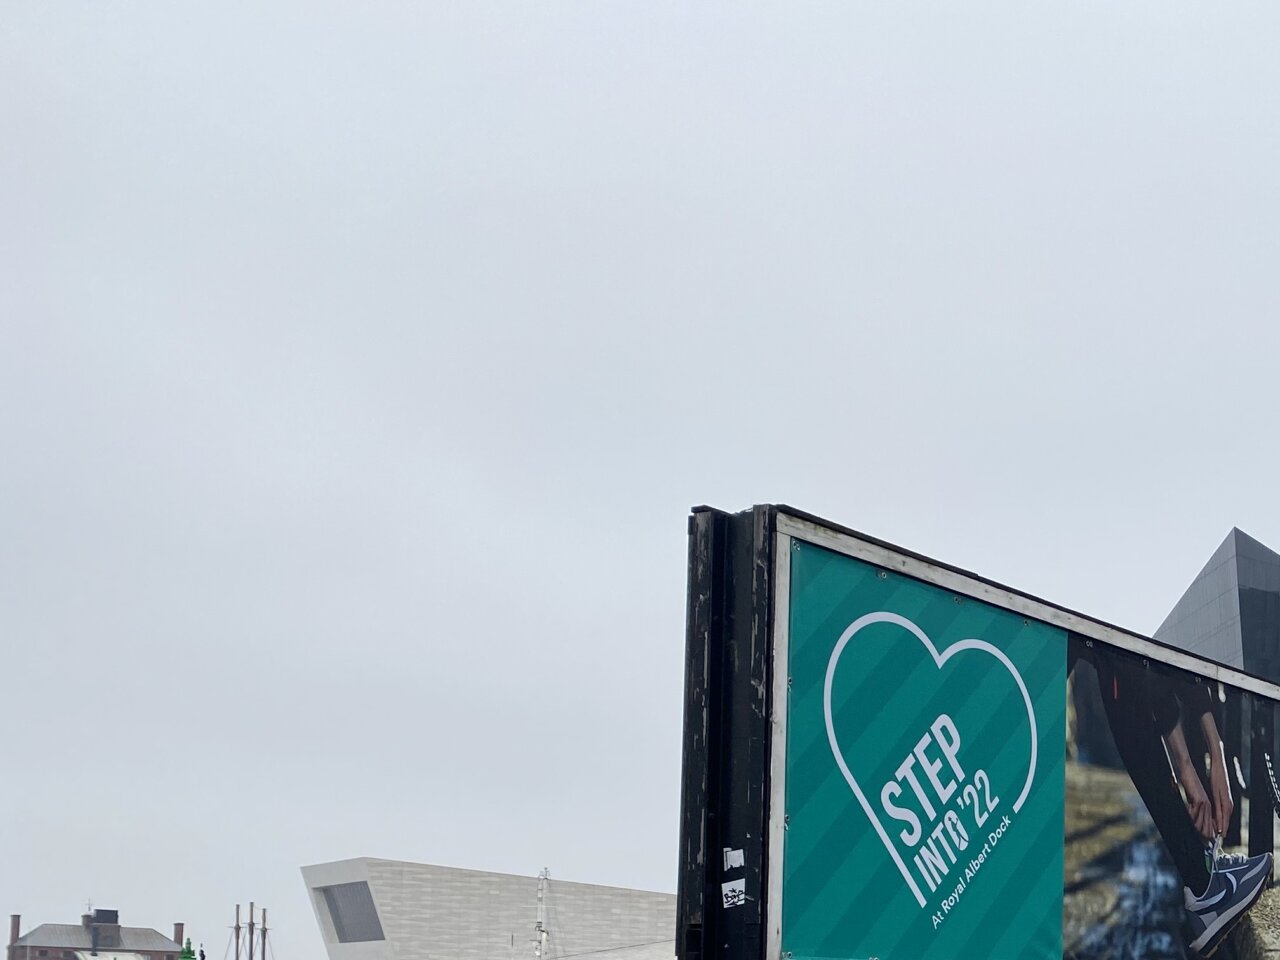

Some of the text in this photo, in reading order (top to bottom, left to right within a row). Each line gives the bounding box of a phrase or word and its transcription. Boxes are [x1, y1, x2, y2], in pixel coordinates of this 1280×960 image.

[881, 713, 965, 847] STEP
[913, 810, 969, 893] INTO
[931, 815, 1012, 930] At Royal Albert Dock
